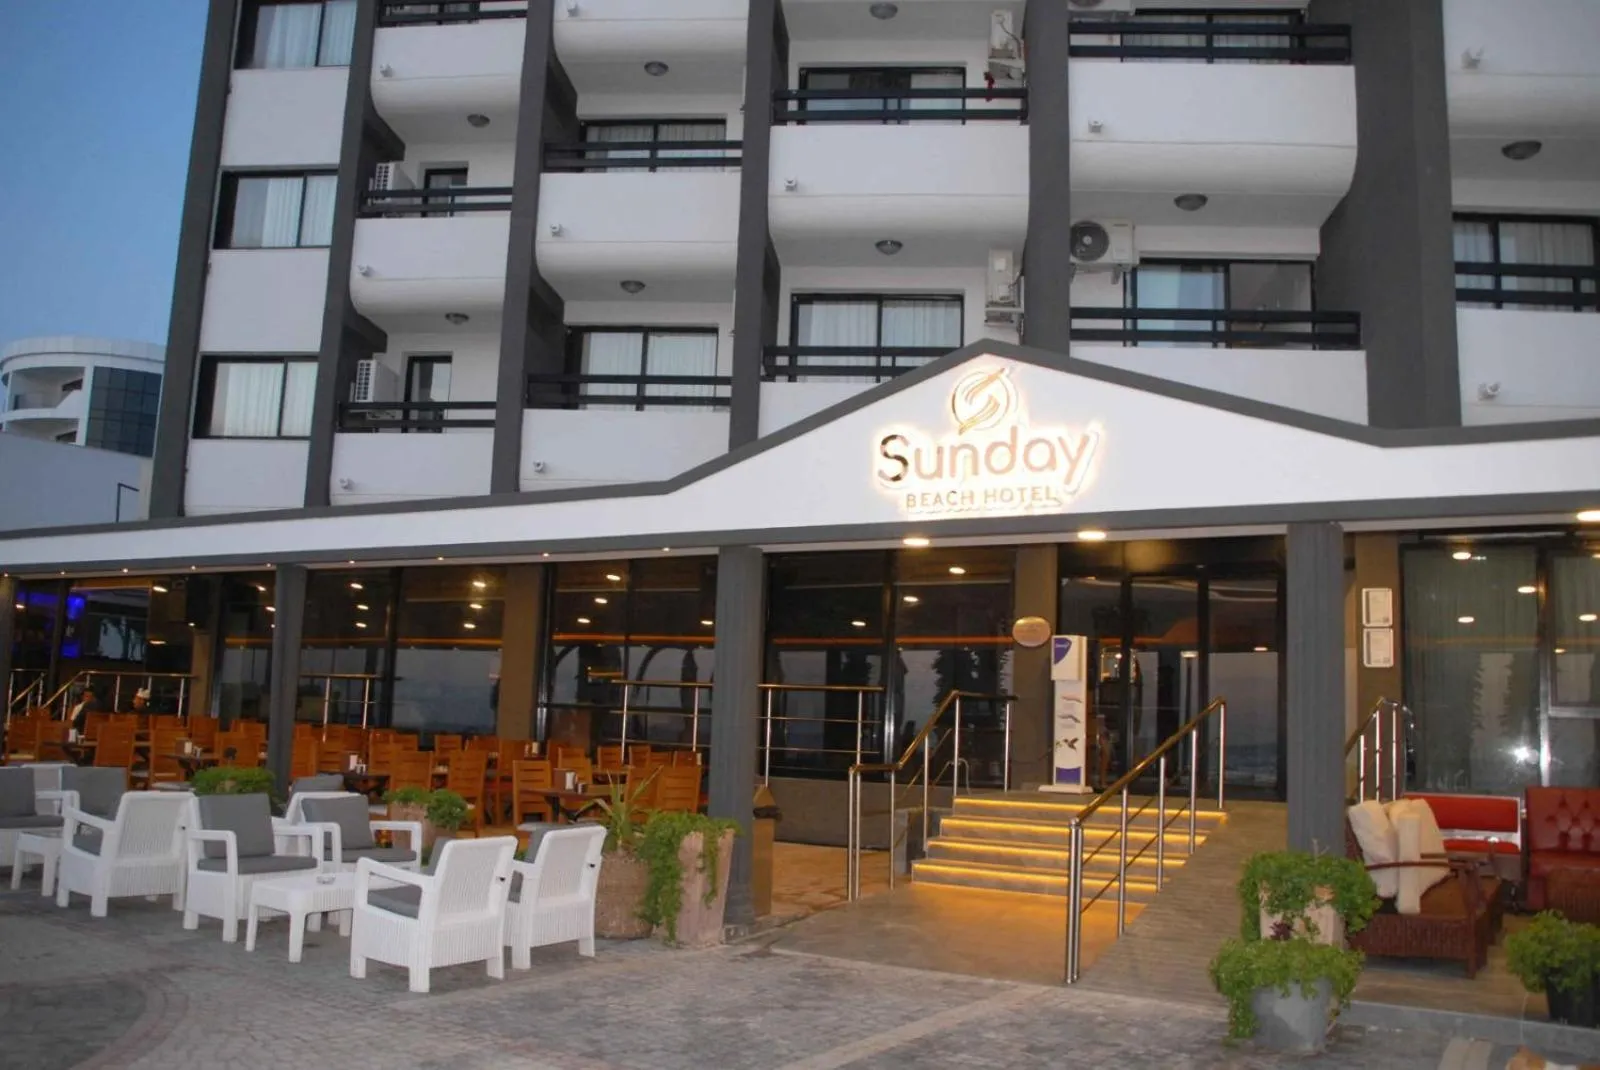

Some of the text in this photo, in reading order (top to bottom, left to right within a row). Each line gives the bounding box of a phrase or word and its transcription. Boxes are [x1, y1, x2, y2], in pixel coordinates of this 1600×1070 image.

[878, 425, 1090, 486] Sunday
[906, 485, 1057, 508] BEACH HOTEL
